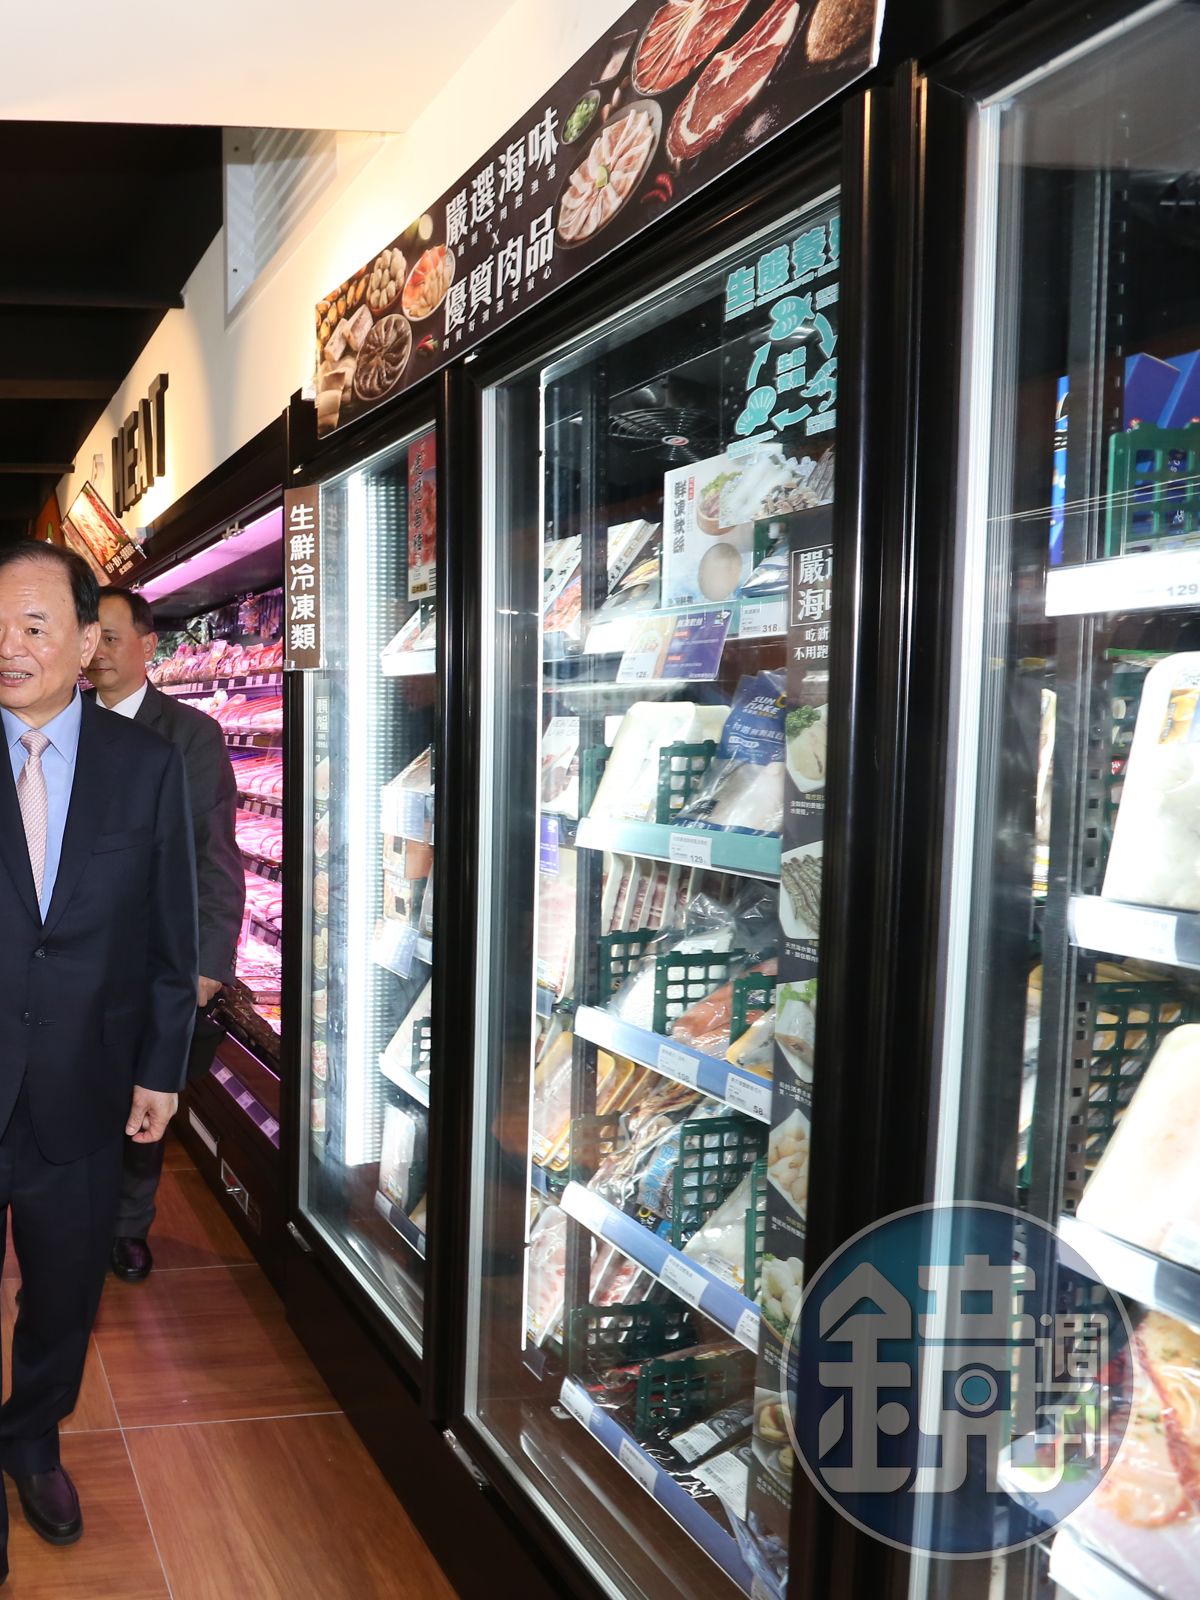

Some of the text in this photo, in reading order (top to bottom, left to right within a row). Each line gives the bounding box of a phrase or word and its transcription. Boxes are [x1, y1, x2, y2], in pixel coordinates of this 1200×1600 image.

[445, 106, 559, 248] 嚴選海味
[444, 205, 555, 336] 優質肉品
[112, 373, 169, 518] MEAT
[289, 503, 316, 650] 生鮮冷凍類
[1167, 583, 1199, 597] 129
[753, 1105, 764, 1116] 58
